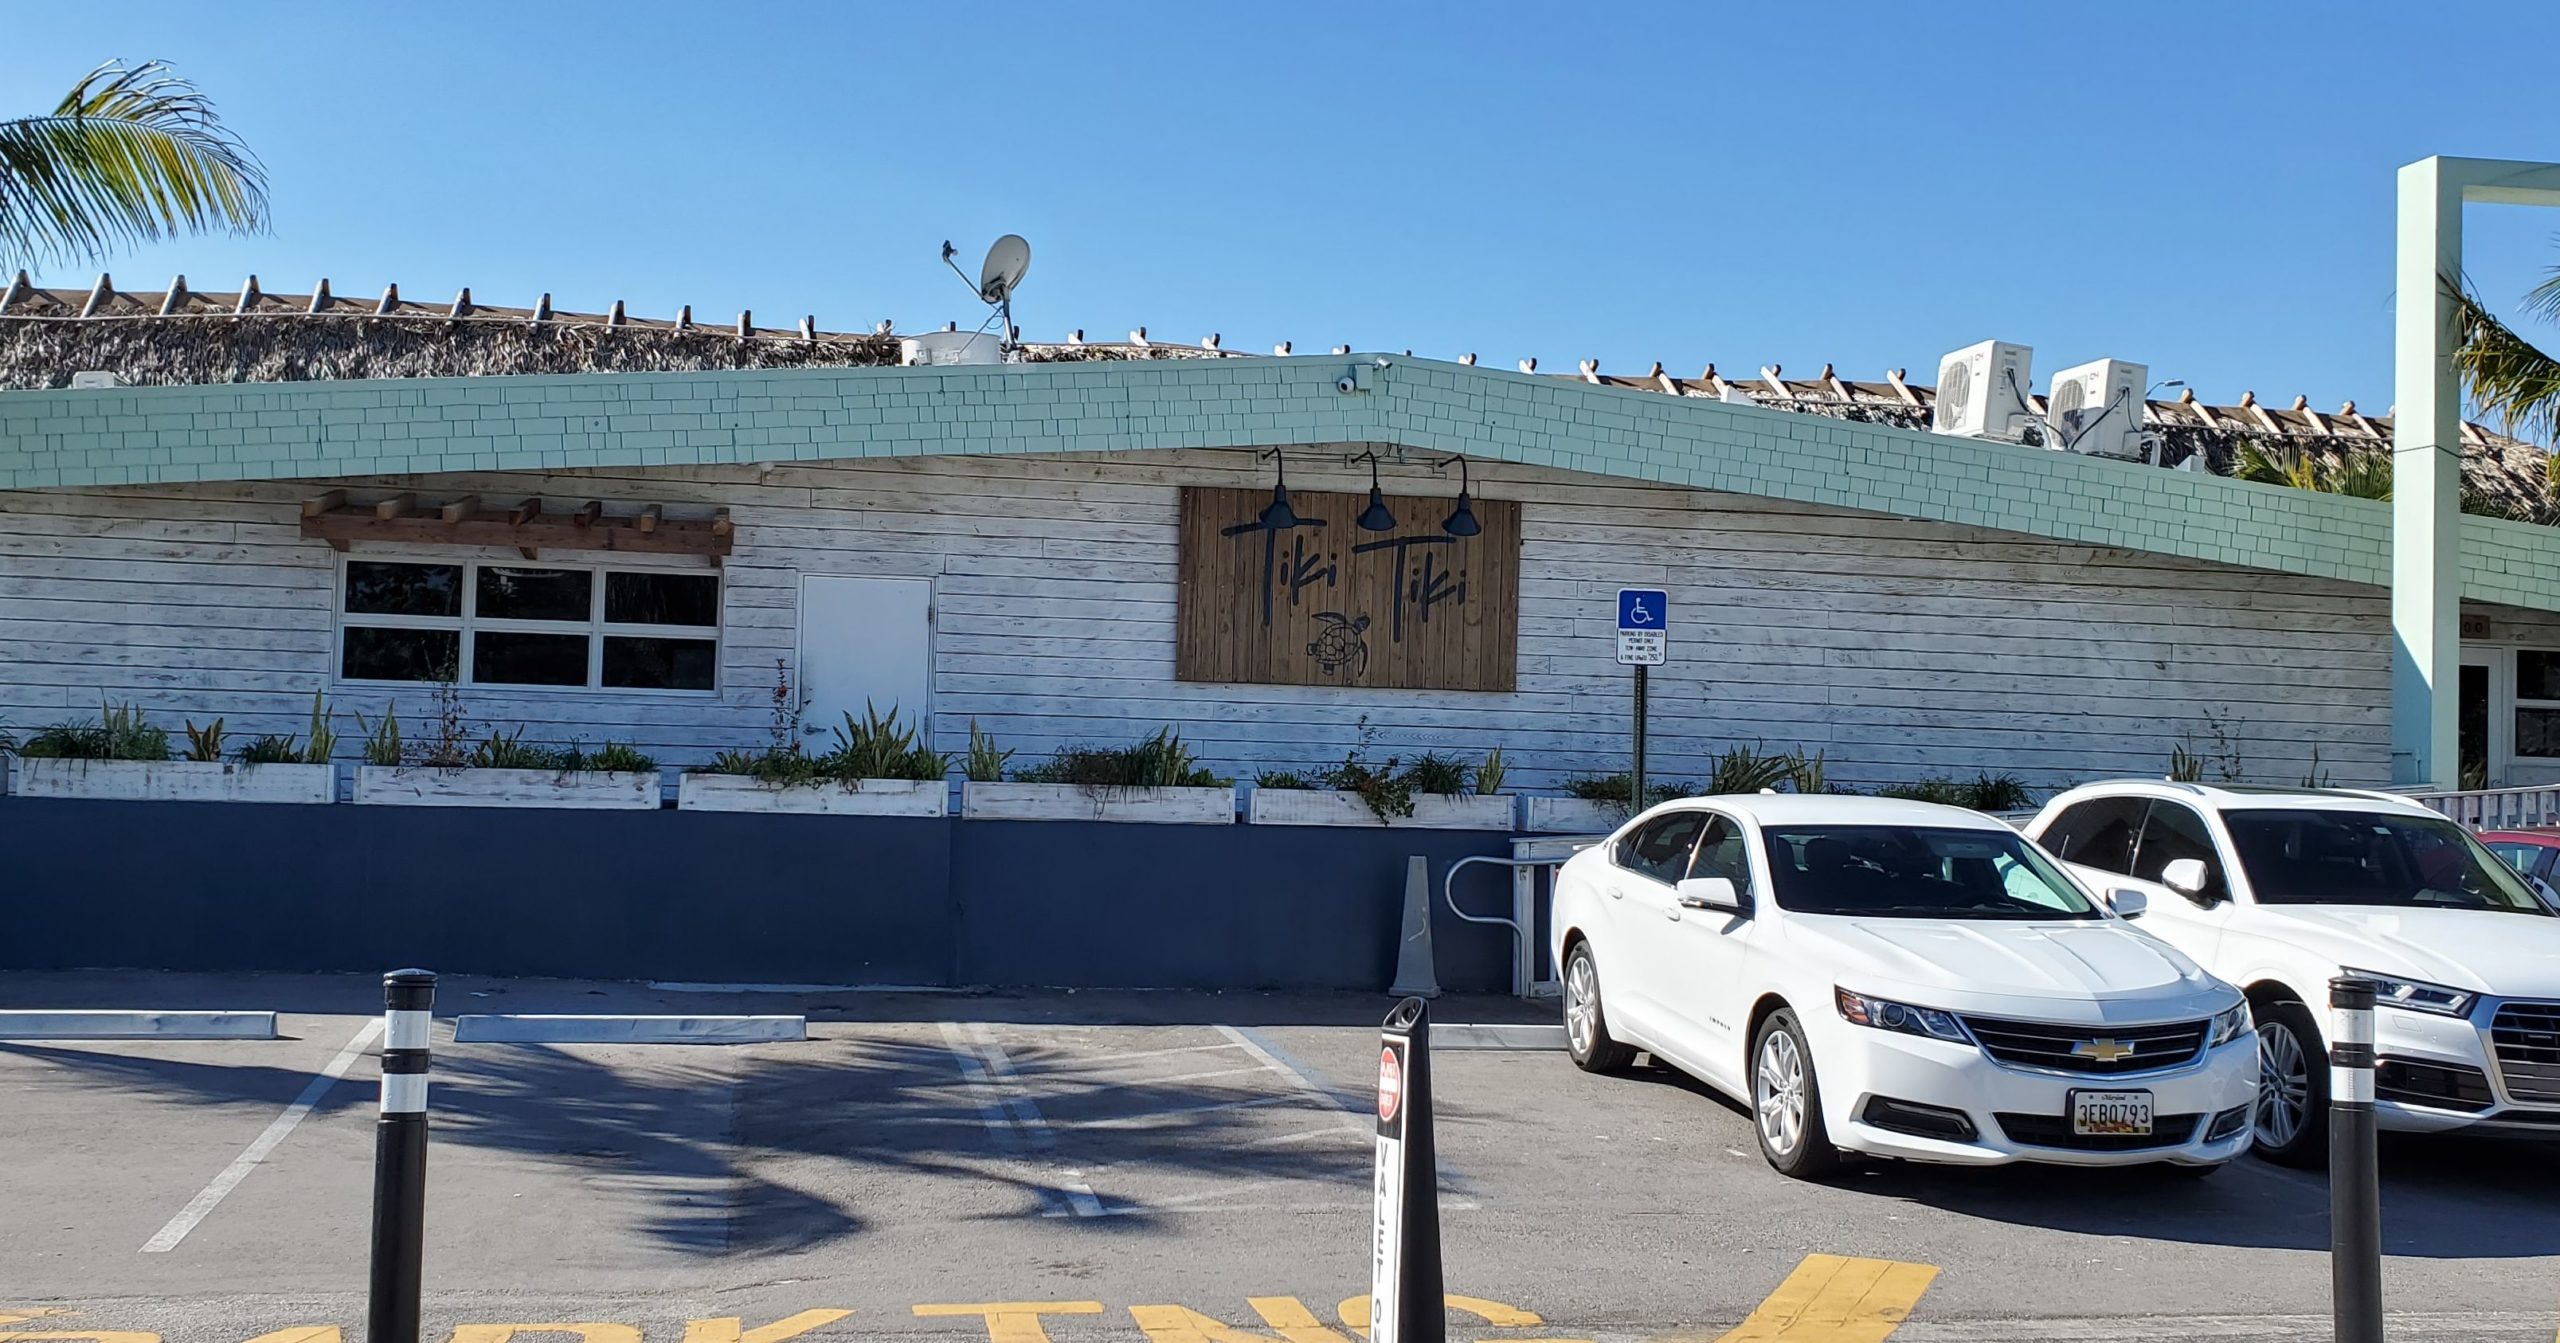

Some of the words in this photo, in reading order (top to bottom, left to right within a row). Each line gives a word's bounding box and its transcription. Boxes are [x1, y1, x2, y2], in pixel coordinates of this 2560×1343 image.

[1220, 518, 1338, 627] Tiki
[1351, 535, 1467, 643] Tiki
[2079, 1104, 2149, 1125] 3EB0793
[1377, 1141, 1388, 1284] VALET
